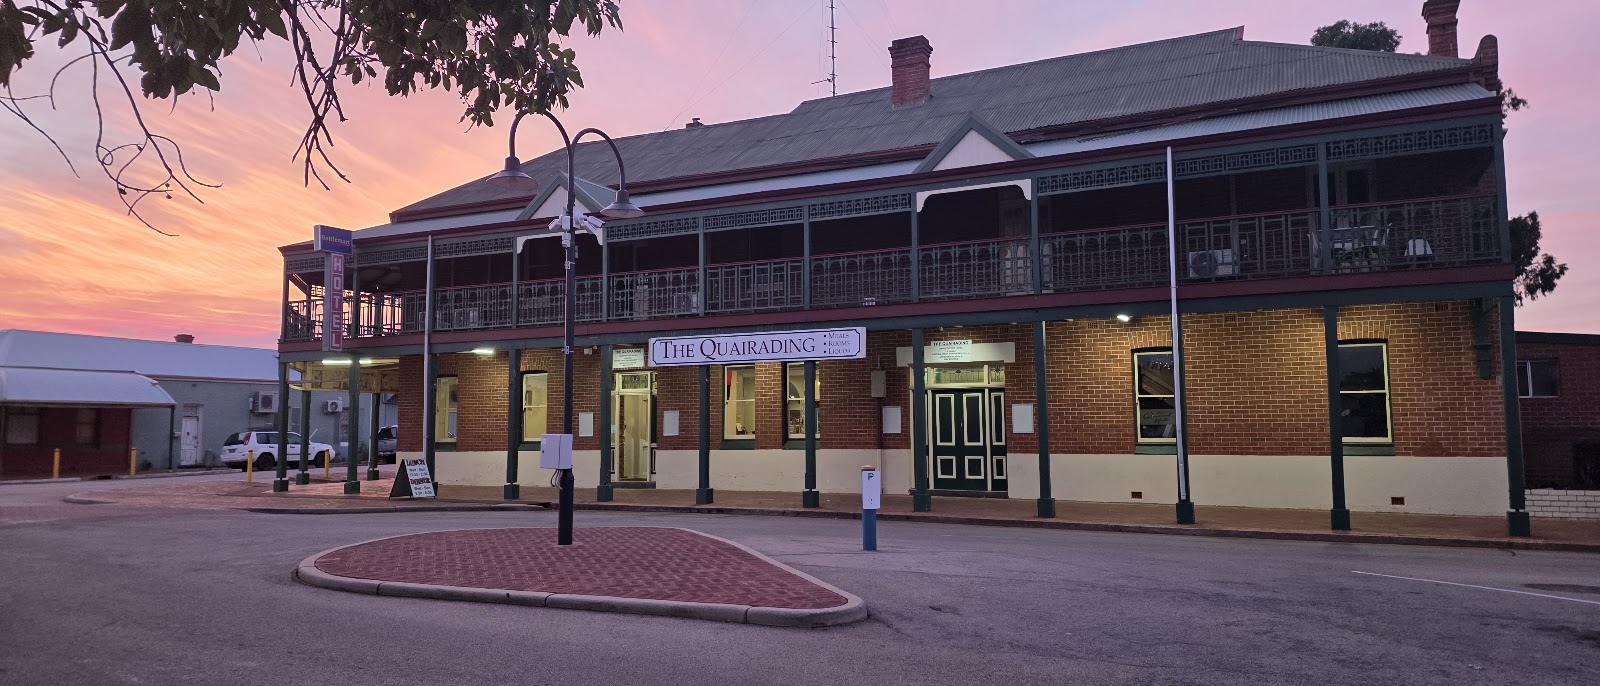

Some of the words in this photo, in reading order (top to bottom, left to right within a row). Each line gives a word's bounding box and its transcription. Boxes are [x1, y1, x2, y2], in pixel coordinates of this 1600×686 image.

[321, 234, 350, 246] Bottlemart
[332, 257, 342, 348] HOTEL
[660, 341, 695, 359] THE
[700, 337, 816, 360] QUAIRADING
